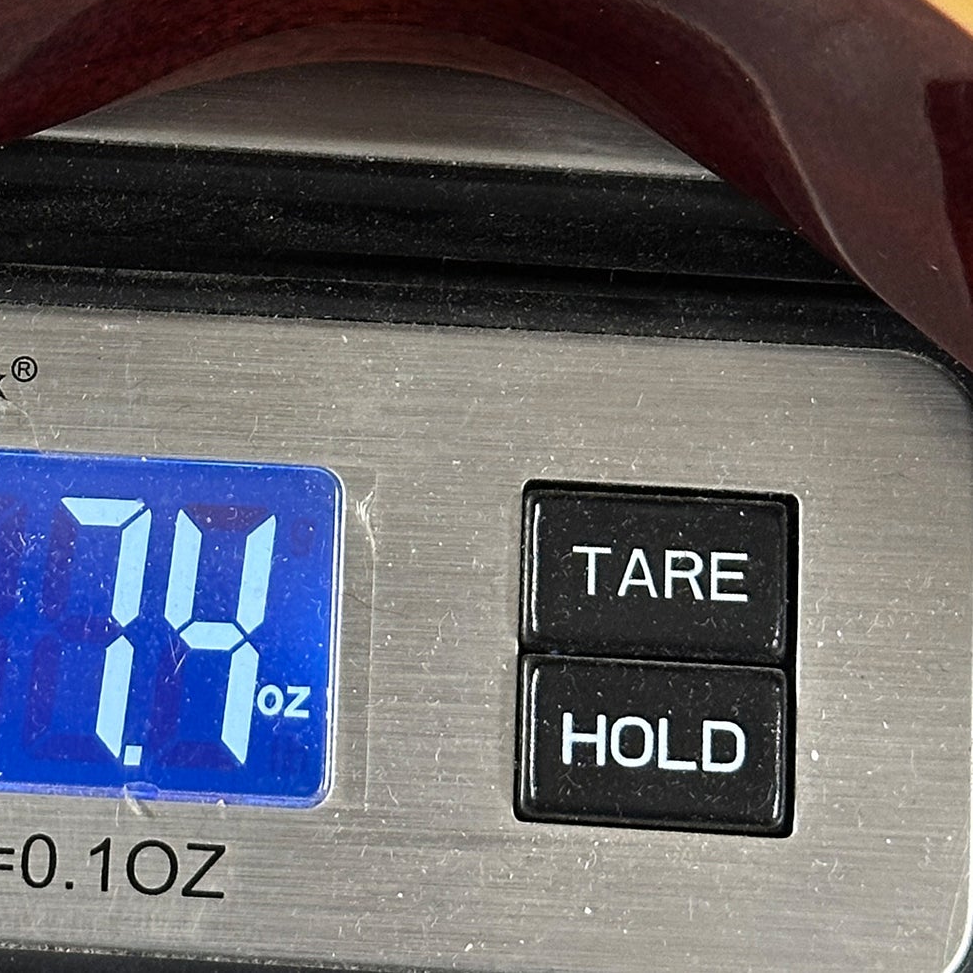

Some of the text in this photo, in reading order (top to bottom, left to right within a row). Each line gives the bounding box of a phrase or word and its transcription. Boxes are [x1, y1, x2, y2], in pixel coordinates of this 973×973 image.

[572, 545, 749, 602] TARE
[60, 496, 277, 766] 7.4
[255, 684, 312, 719] oz
[561, 711, 747, 774] HOLD
